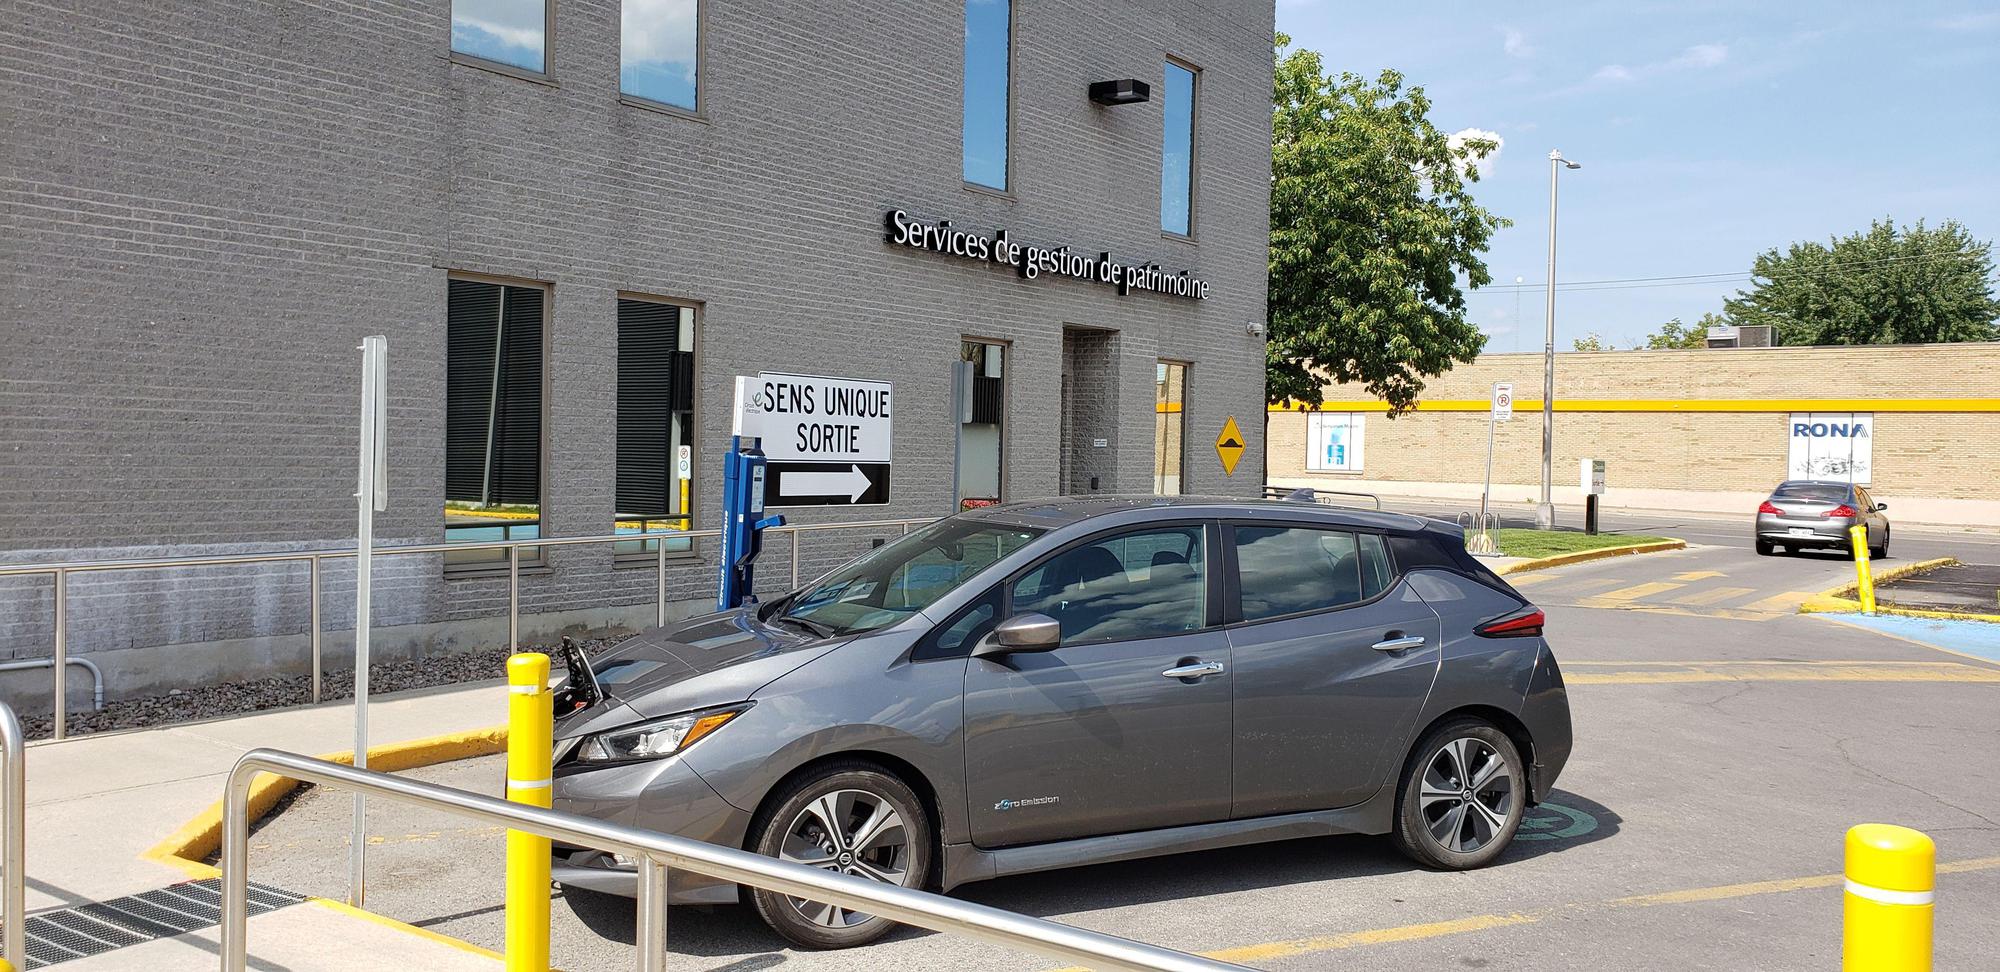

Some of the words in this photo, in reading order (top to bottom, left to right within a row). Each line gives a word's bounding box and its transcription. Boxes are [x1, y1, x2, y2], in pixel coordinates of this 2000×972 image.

[894, 209, 988, 259] Services
[995, 230, 1020, 266] de
[1027, 246, 1094, 279] gestion
[1100, 252, 1121, 285] de
[1126, 264, 1210, 300] patrimoine
[763, 382, 815, 415] SENS
[824, 386, 889, 418] UNIQUE
[796, 422, 860, 453] SORTIE
[1793, 423, 1869, 438] RONA
